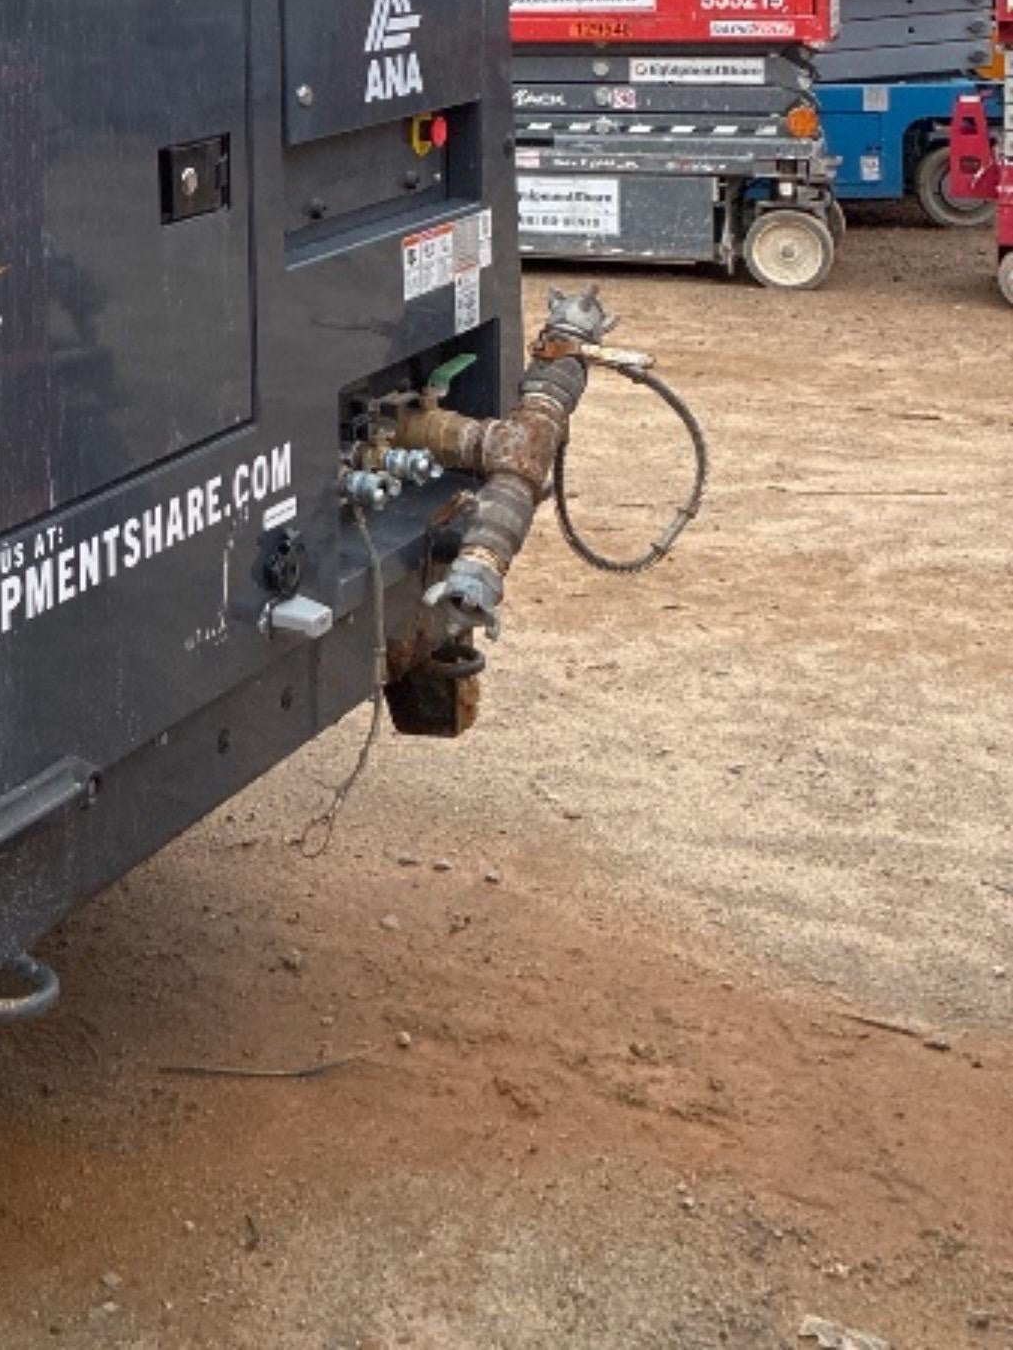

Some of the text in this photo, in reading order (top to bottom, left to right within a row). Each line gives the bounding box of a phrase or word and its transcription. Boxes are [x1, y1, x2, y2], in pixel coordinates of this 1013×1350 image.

[365, 54, 423, 103] ANA
[0, 542, 24, 574] US
[33, 526, 63, 558] AT:
